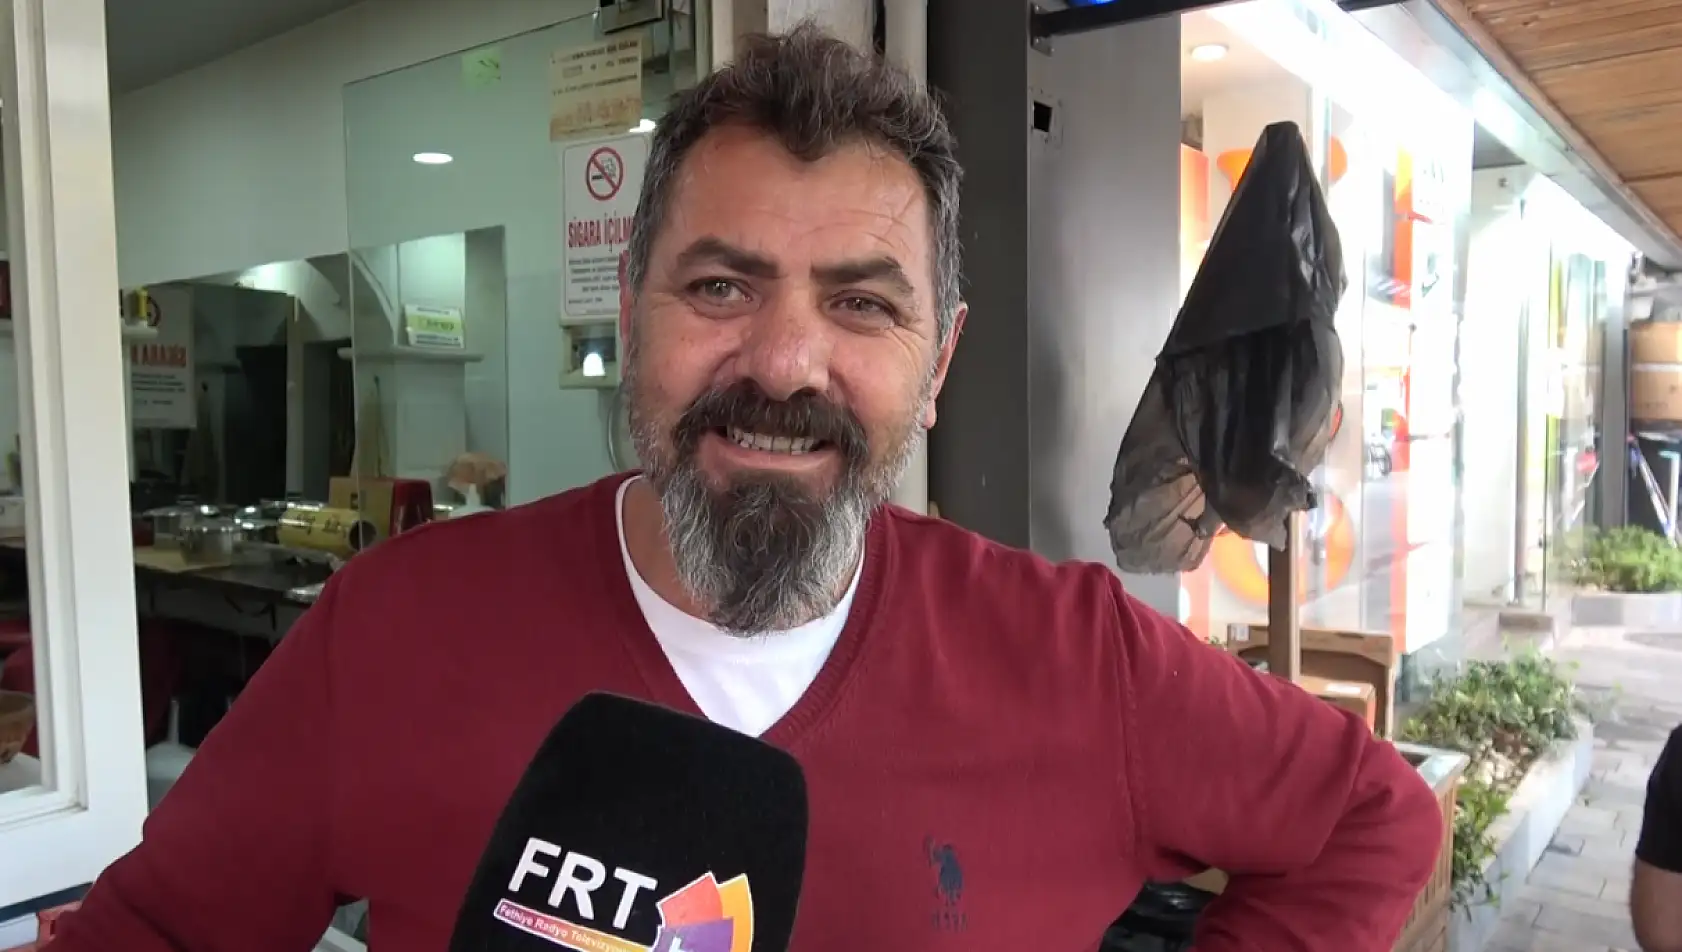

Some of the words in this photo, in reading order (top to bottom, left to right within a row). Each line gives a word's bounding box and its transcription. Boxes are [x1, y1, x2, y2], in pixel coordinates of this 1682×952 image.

[568, 216, 601, 248] SİGARA
[604, 209, 636, 253] İÇİLM
[508, 837, 658, 929] FRT
[500, 904, 534, 926] Fethiye
[535, 917, 568, 938] Radyo
